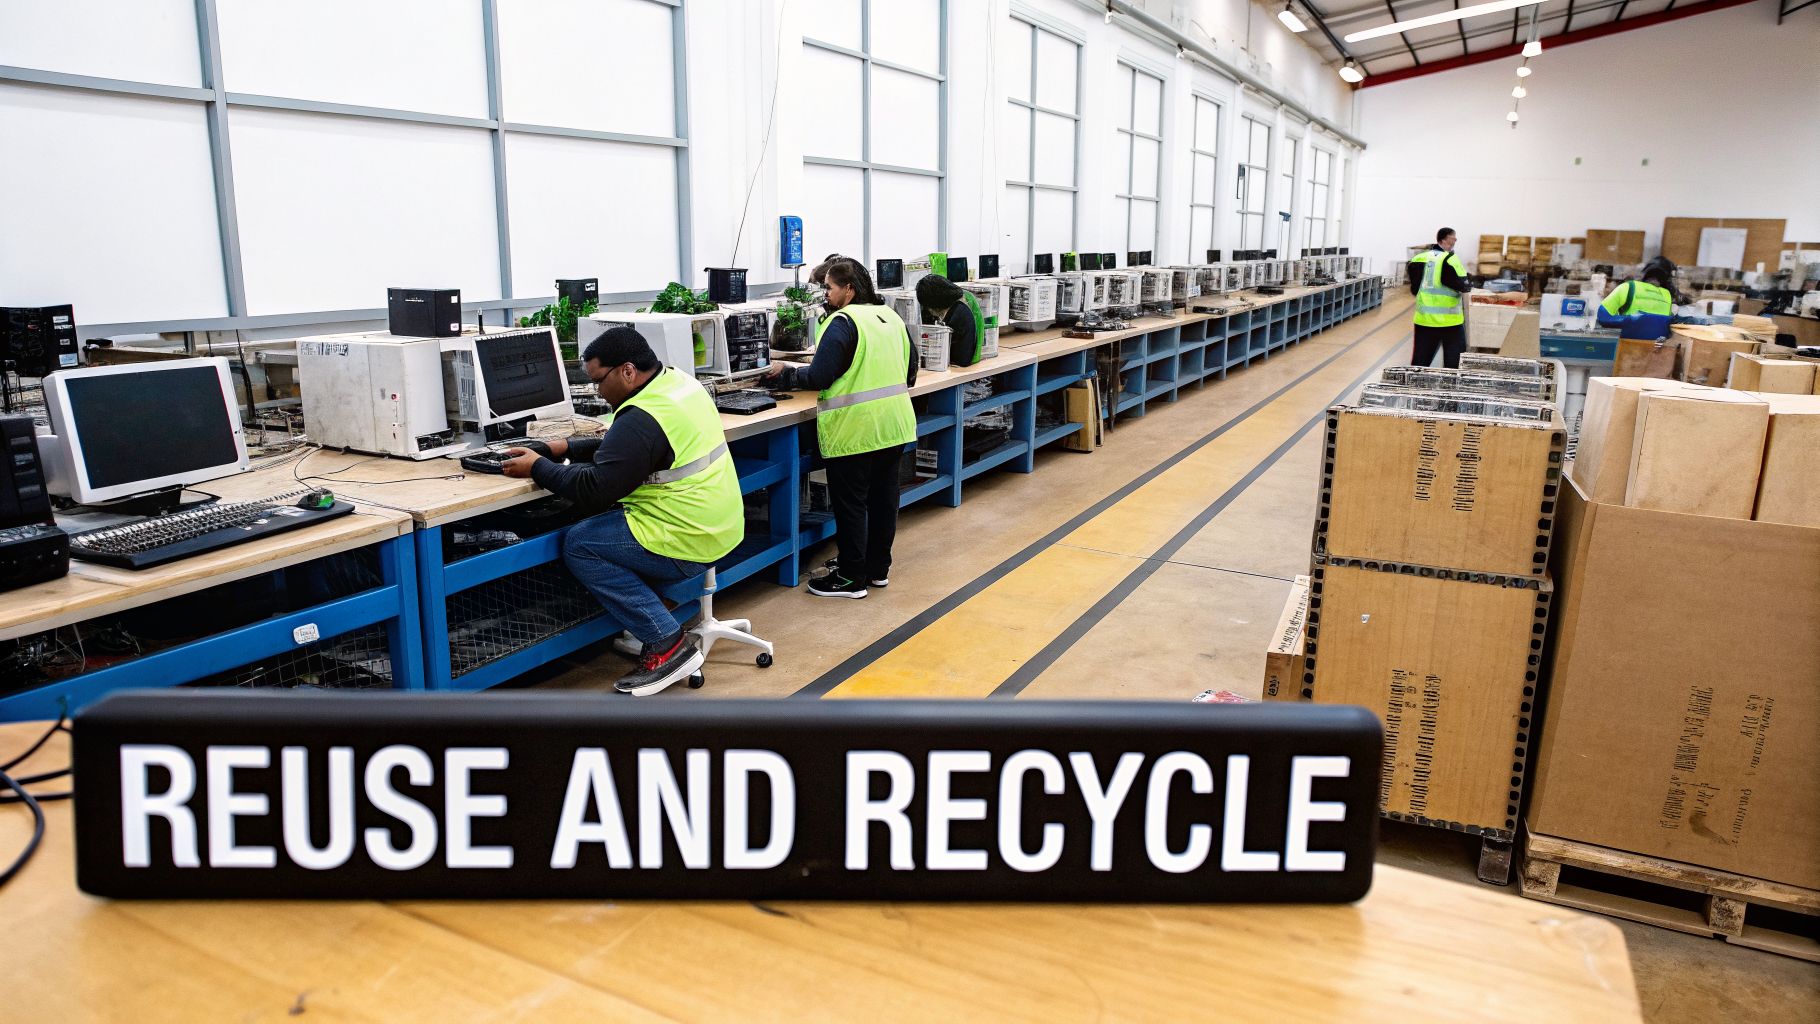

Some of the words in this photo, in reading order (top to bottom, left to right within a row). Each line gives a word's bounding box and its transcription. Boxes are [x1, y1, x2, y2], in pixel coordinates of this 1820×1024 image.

[120, 745, 514, 871] REUSE
[550, 747, 795, 870] AND
[845, 750, 1351, 874] RECYCLE
